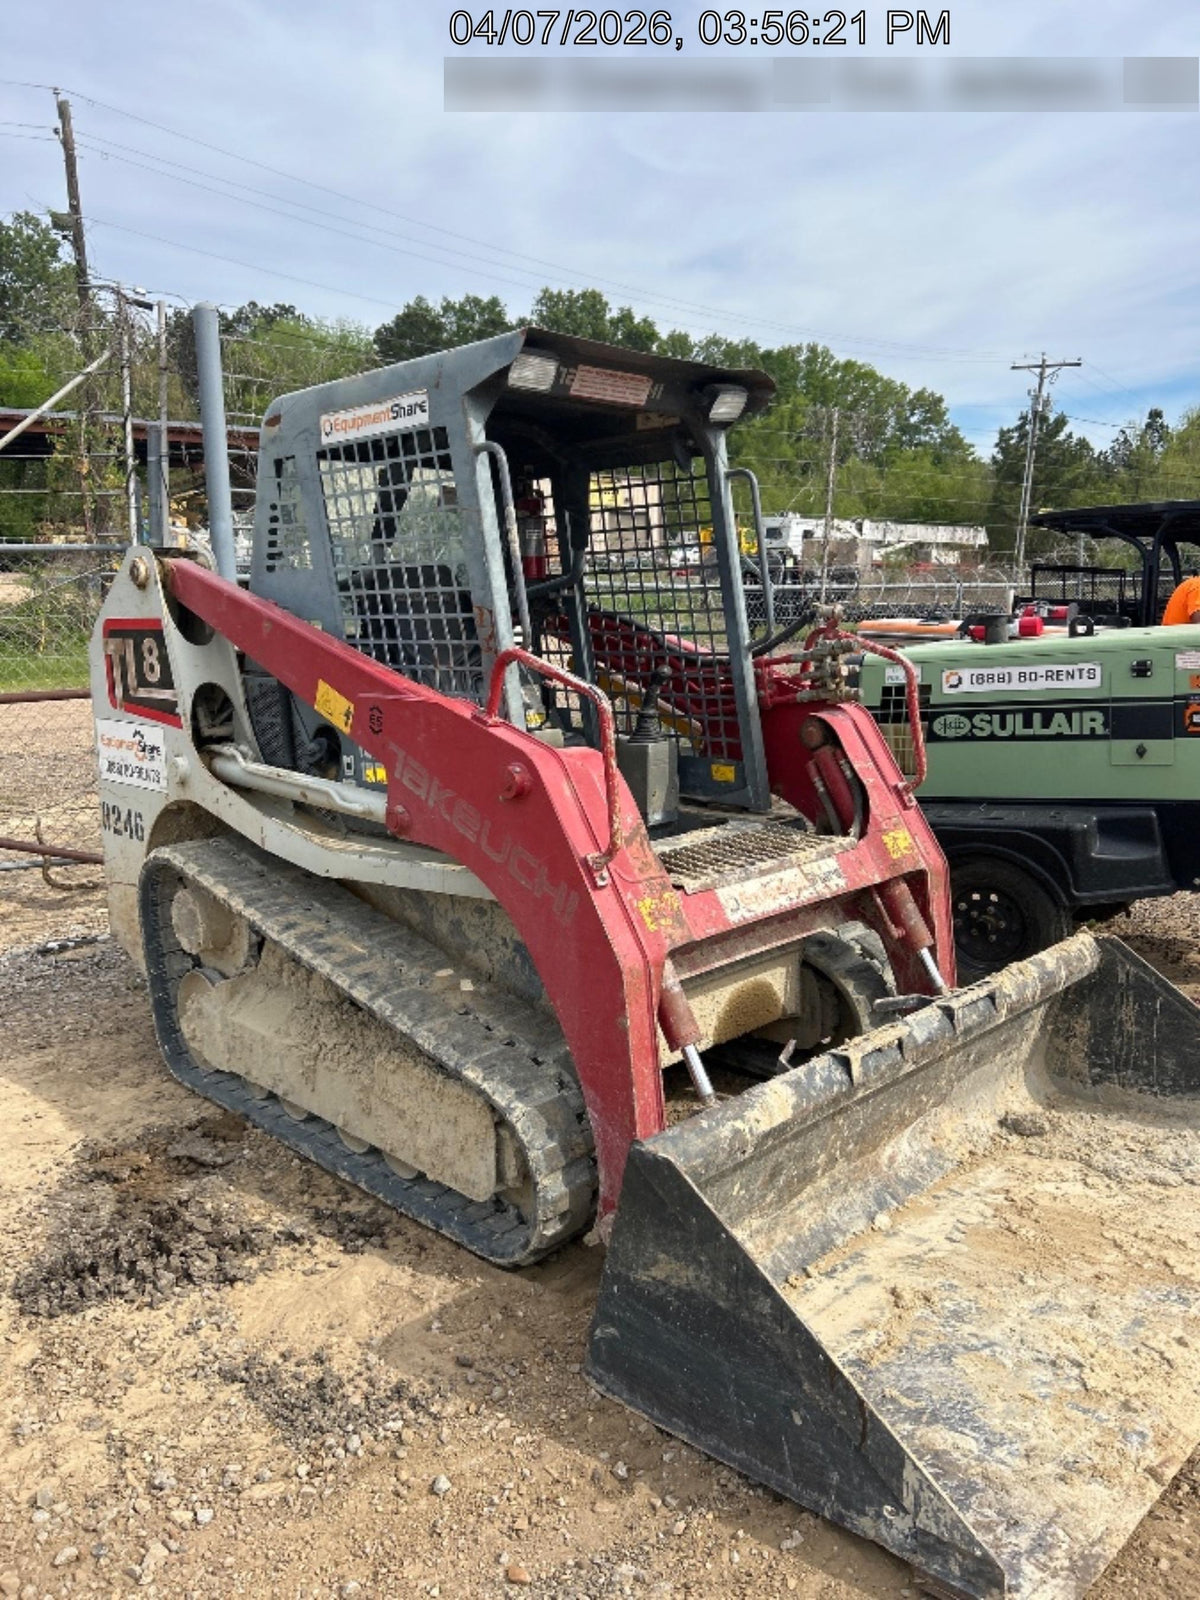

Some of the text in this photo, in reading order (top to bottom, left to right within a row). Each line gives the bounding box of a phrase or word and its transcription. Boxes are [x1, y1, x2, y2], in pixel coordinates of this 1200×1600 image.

[333, 400, 427, 433] EquipmentShare
[970, 671, 1012, 685] (888)
[972, 711, 1105, 737] SULLAIR
